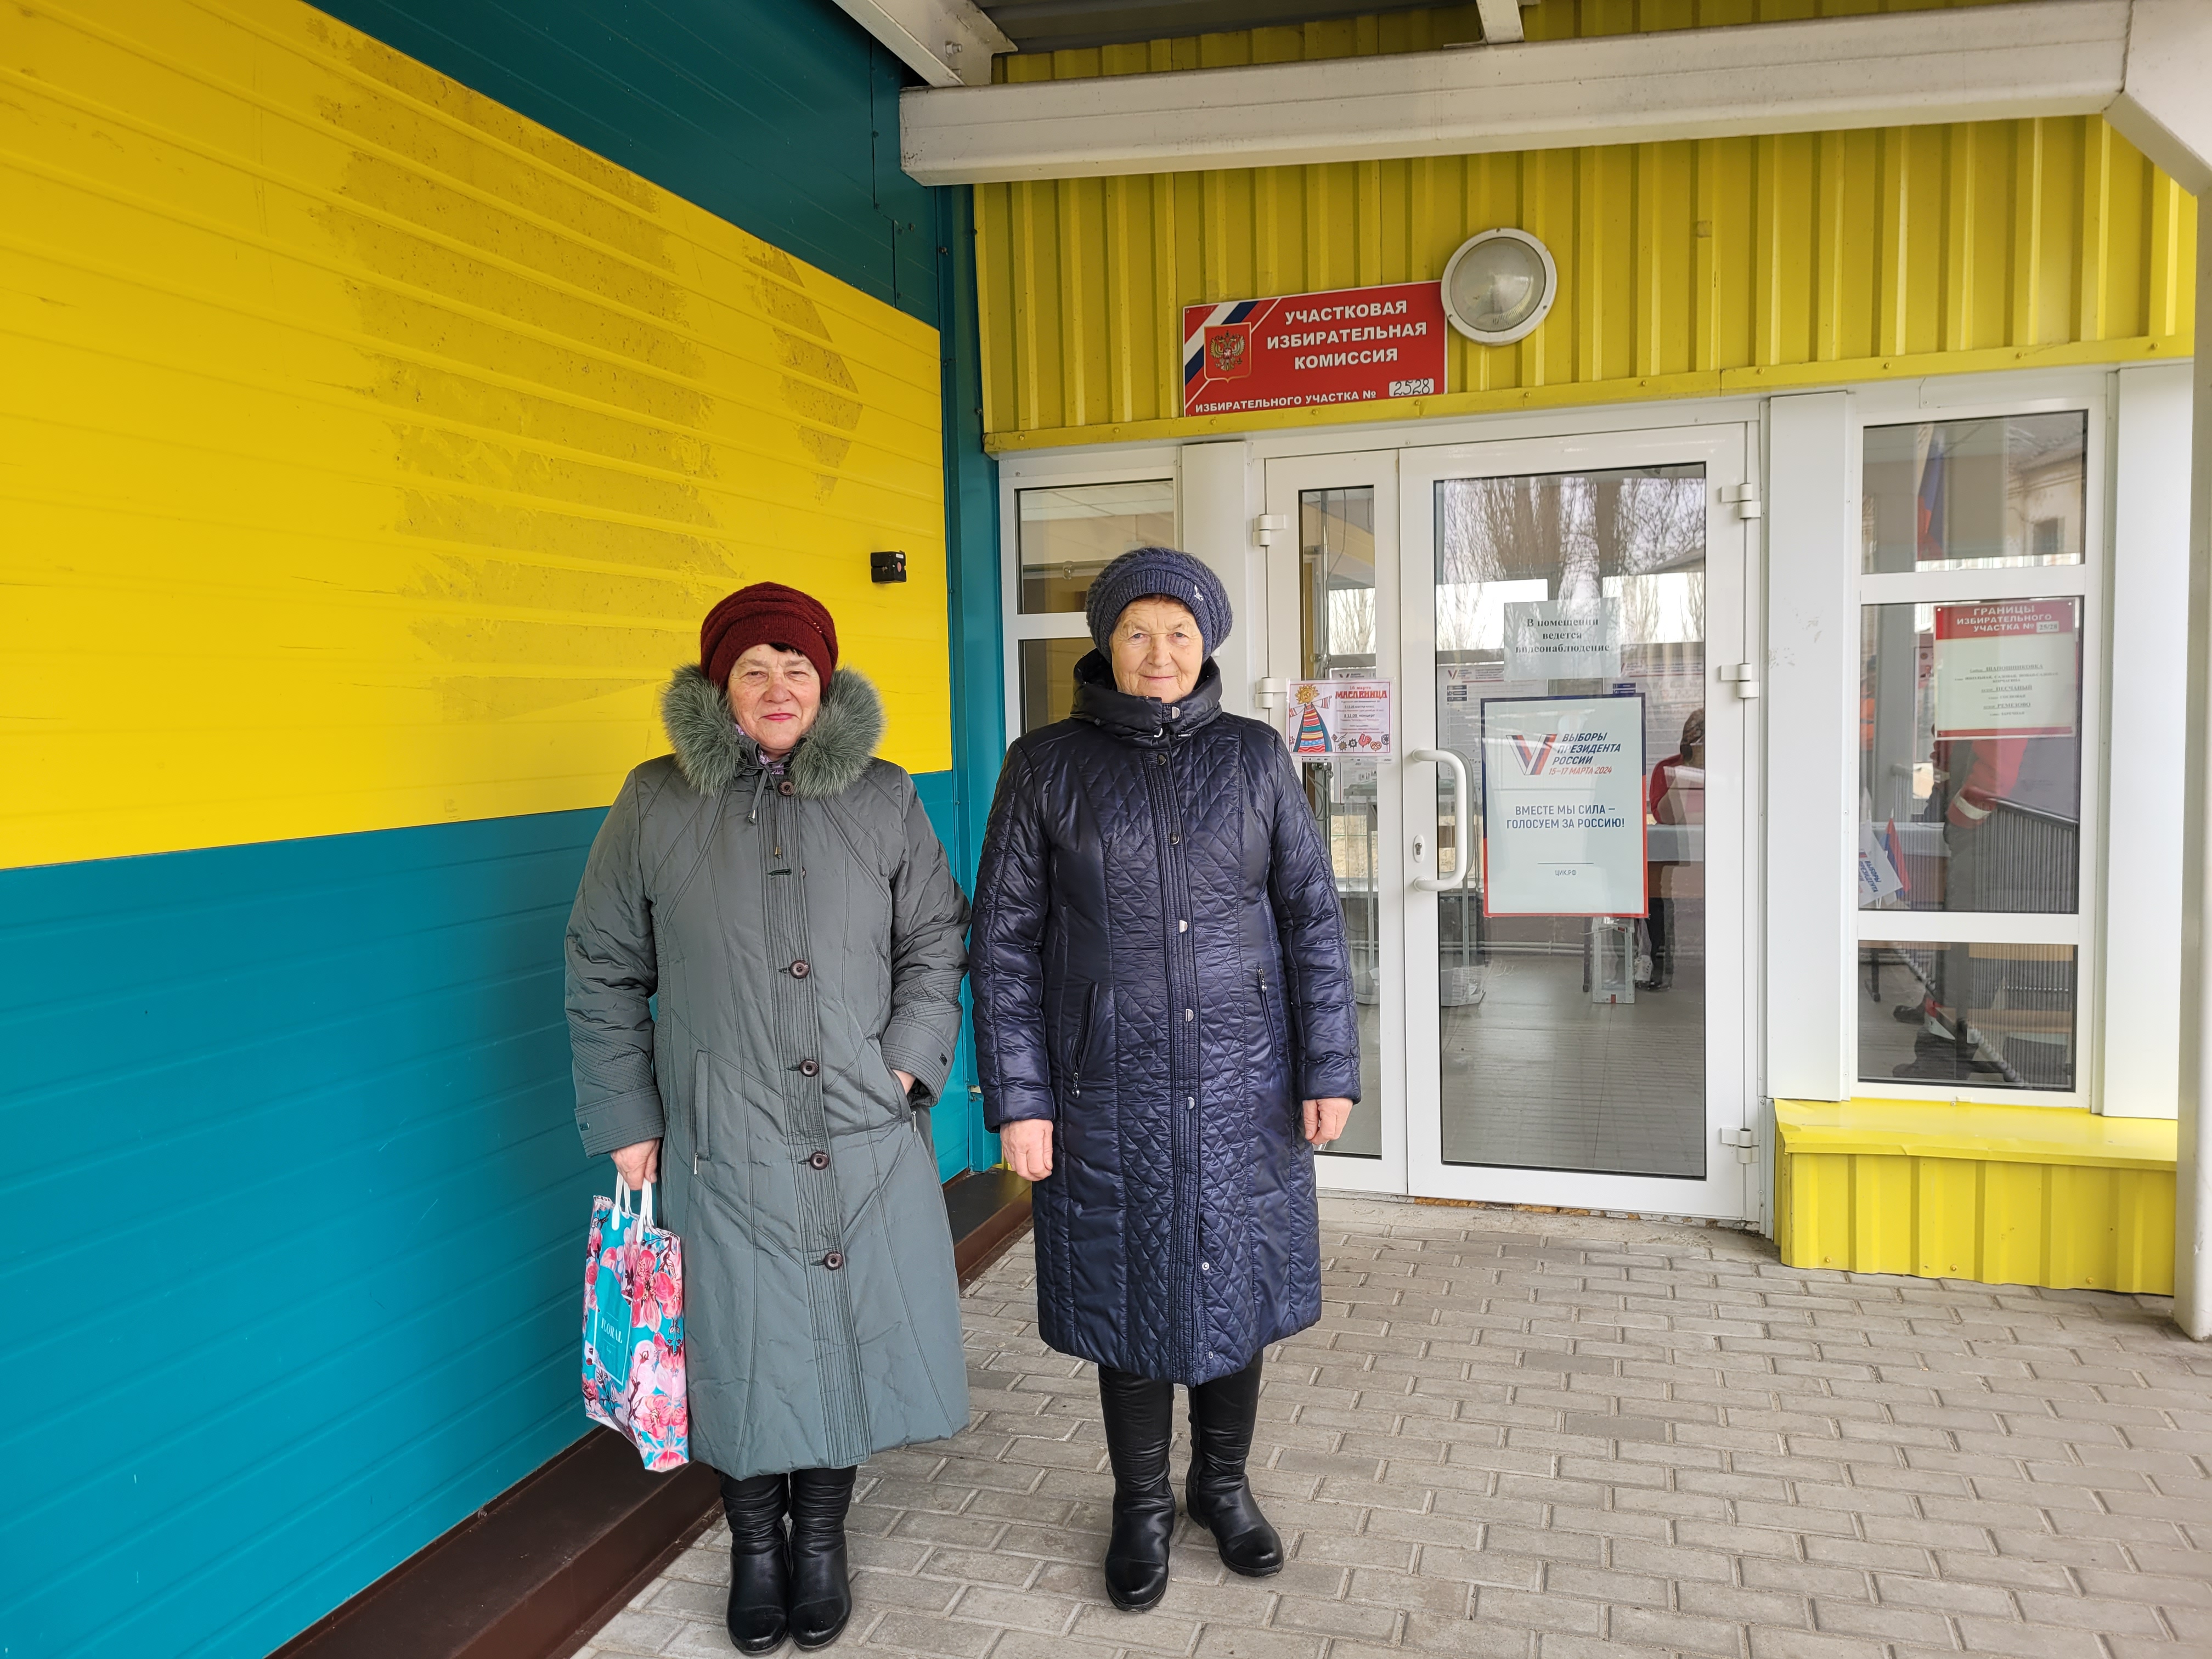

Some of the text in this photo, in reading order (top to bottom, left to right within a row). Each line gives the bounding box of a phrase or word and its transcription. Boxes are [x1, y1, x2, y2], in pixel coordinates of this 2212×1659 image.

[1285, 300, 1407, 325] УЧАСТКОВАЯ
[1267, 321, 1426, 349] ИЗБИРАТЕЛЬНАЯ
[1294, 348, 1398, 370] КОМИССИЯ
[1195, 396, 1302, 413] ИЗБИРАТЕЛЬНОГО
[1305, 391, 1359, 405] УЧАСТКА
[1362, 390, 1376, 399] №
[1973, 605, 2035, 616] ГРАНИЦЫ
[1527, 618, 1599, 627] В помещении
[1957, 613, 2052, 625] ИЗБИРАТЕЛЬНОГО
[1973, 624, 2019, 633] УЧАСТКА
[1515, 644, 1610, 653] видеонаблюдение
[1562, 732, 1607, 742] ВЫБОРЫ
[1557, 743, 1621, 754] ПРЕЗИДЕНТА
[1552, 756, 1594, 765] РОССИИ
[1515, 806, 1554, 815] ВМЕСТЕ
[1558, 805, 1575, 814] МЫ
[1578, 804, 1606, 814] СИЛА
[1506, 818, 1624, 829] ГОЛОСУЕМ ЗА РОССИЮ!
